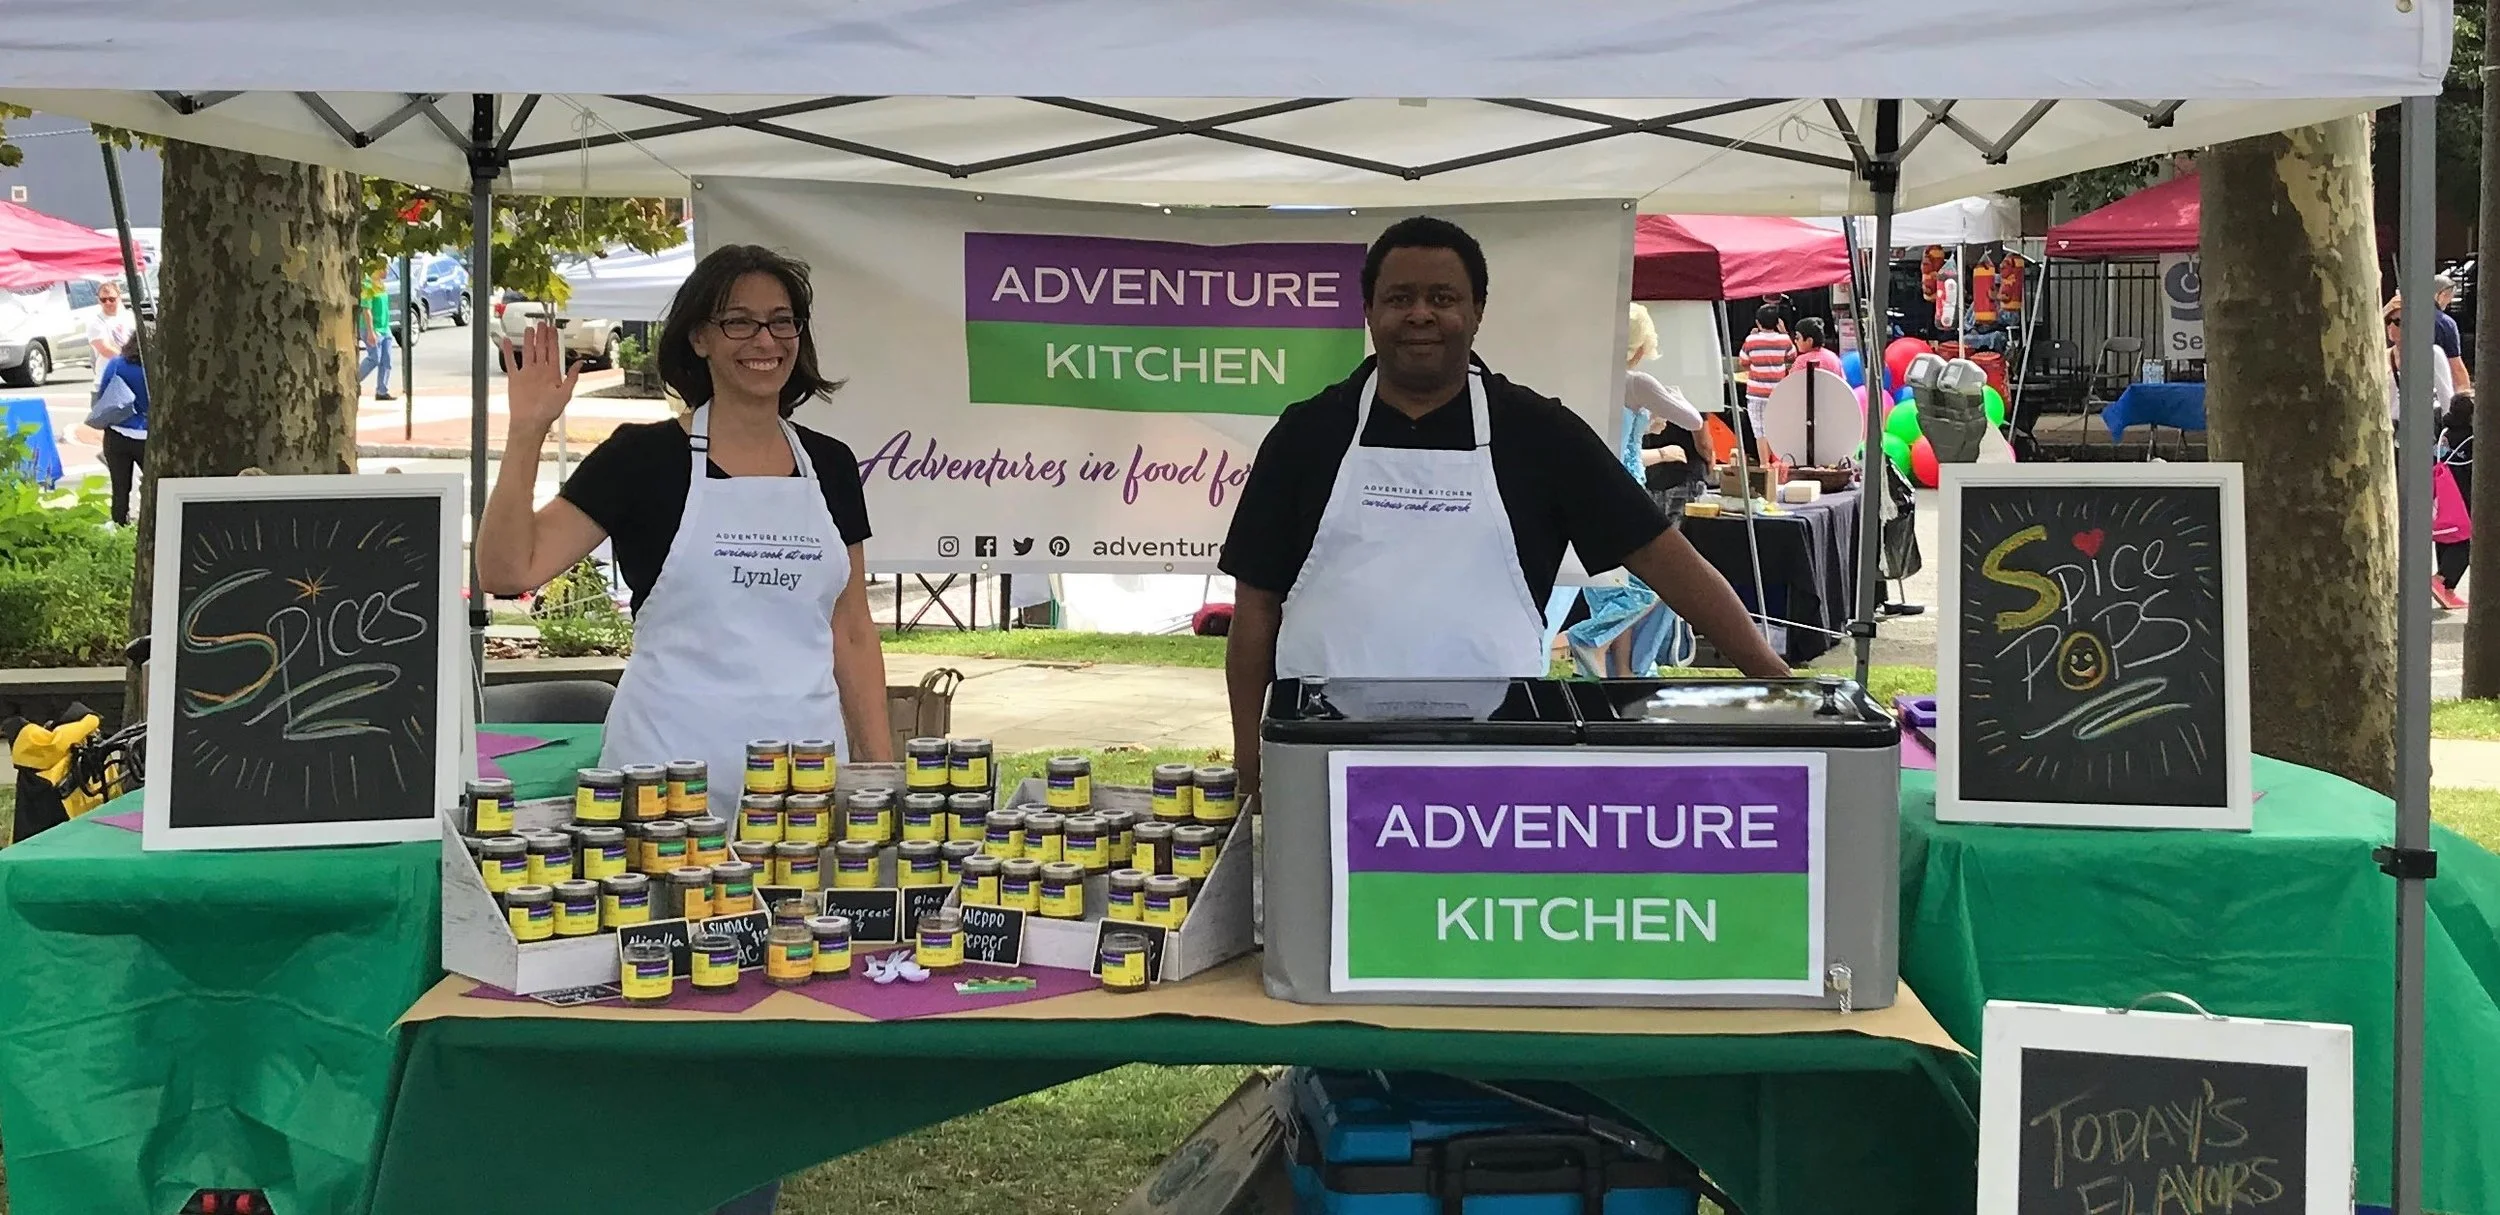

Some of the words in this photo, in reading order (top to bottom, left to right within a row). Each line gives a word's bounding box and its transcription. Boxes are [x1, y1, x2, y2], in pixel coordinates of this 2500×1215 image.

[992, 266, 1340, 308] ADVENTURE
[1046, 343, 1286, 385] KITCHEN
[857, 429, 1067, 488] Adventures
[1078, 452, 1120, 483] in
[1122, 444, 1208, 506] food
[1363, 485, 1424, 496] ADVENTURE
[1428, 489, 1473, 497] KITCHEN
[715, 532, 778, 542] ADVENTURE
[713, 548, 758, 558] curious
[759, 548, 784, 560] cook
[784, 549, 800, 560] at
[799, 550, 823, 561] work
[731, 566, 802, 591] Lynley
[1375, 804, 1779, 850] ADVENTURE
[914, 894, 948, 905] Blac
[1436, 896, 1717, 942] KITCHEN
[963, 932, 1009, 951] epper
[2029, 1078, 2249, 1190] TODAY'S
